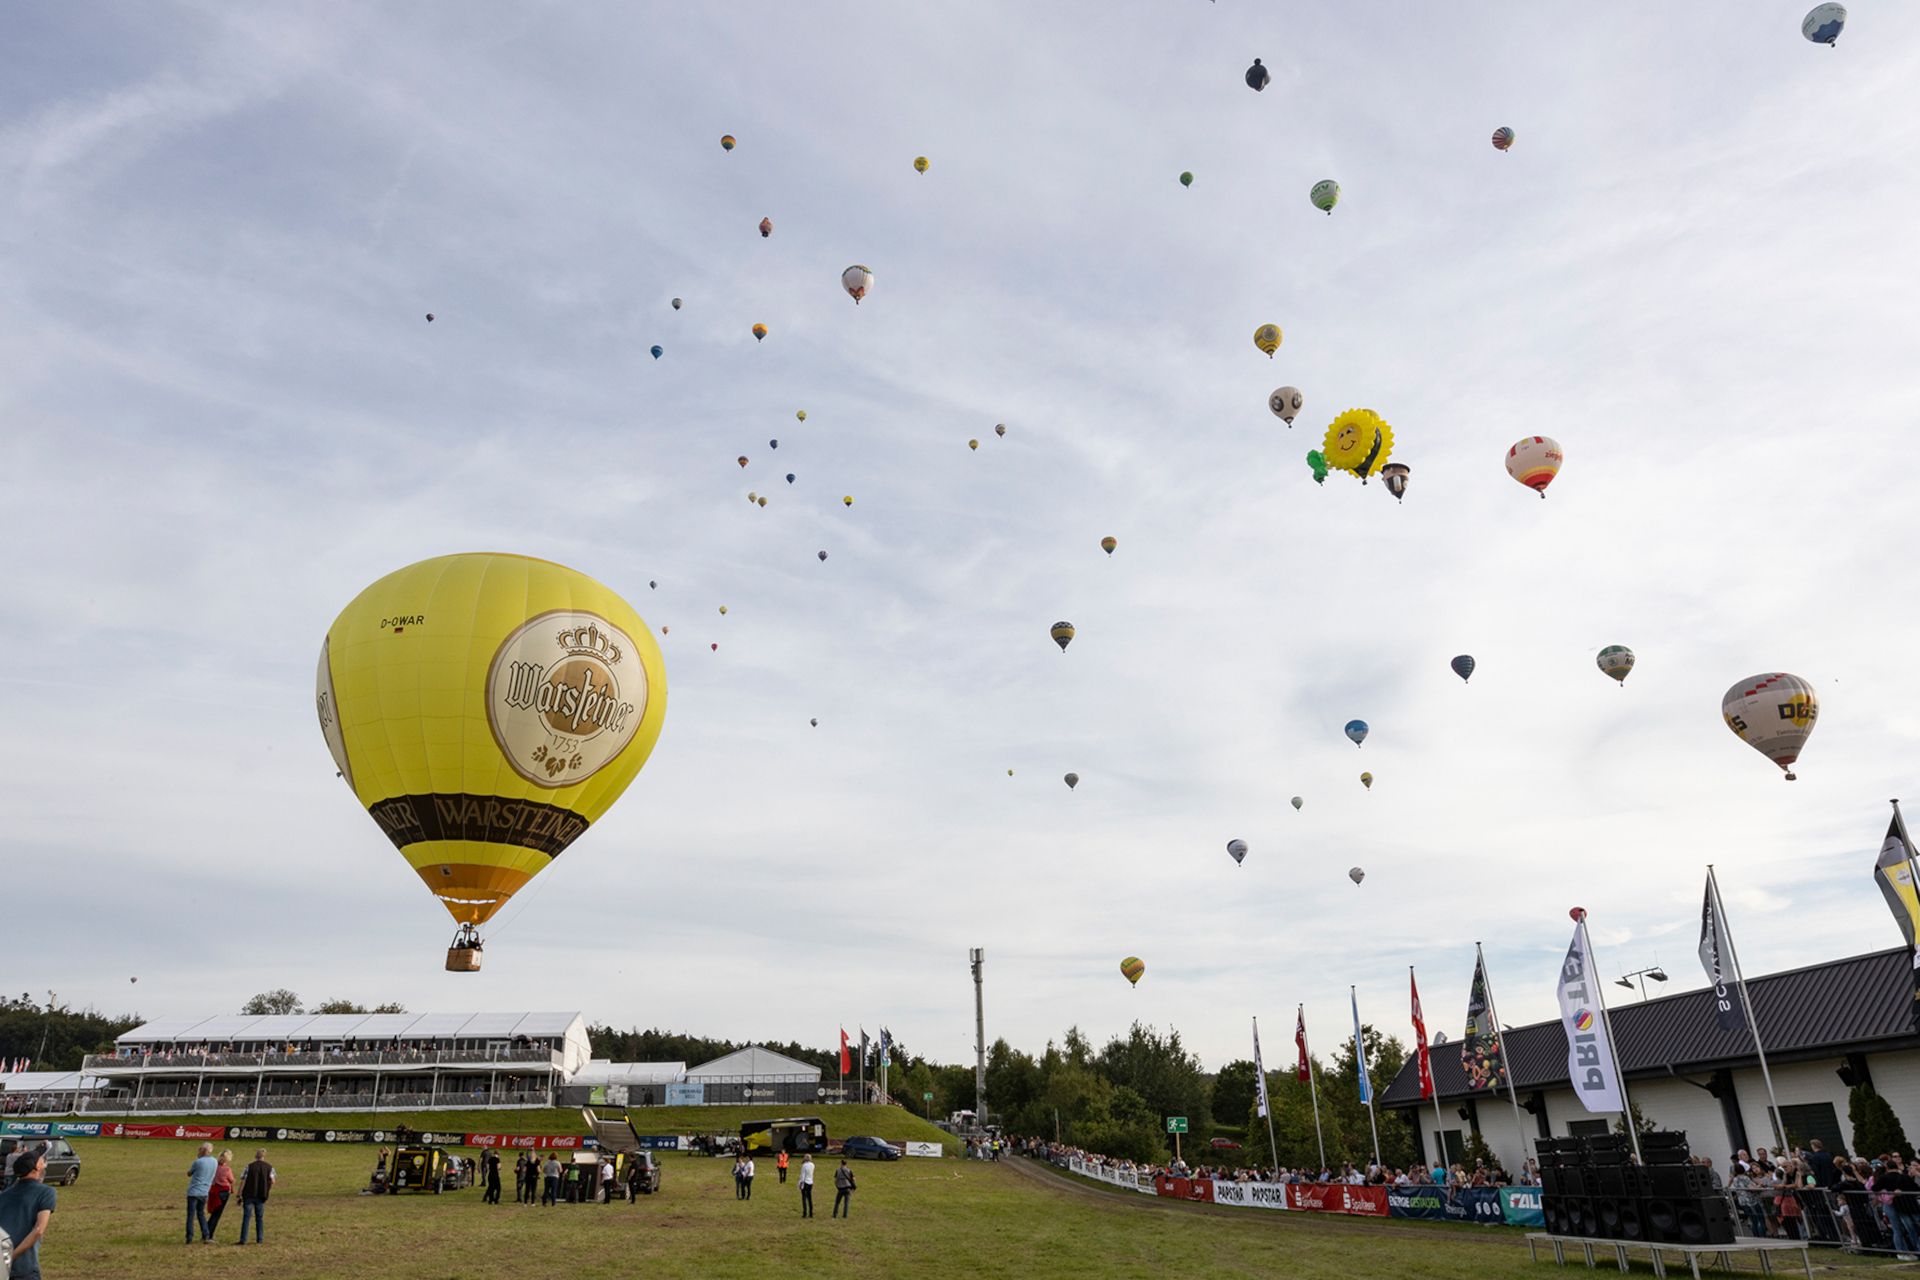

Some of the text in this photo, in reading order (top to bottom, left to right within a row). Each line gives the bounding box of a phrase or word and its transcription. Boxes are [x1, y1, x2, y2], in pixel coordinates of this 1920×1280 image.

[381, 615, 424, 629] D-OWAR
[505, 661, 634, 733] Warsteiner
[553, 735, 579, 754] 1753
[436, 799, 584, 846] WARSTEINER
[57, 1123, 99, 1131] FALKEN
[185, 1130, 212, 1138] Sparkasse
[1251, 1186, 1282, 1204] PAPSTAR
